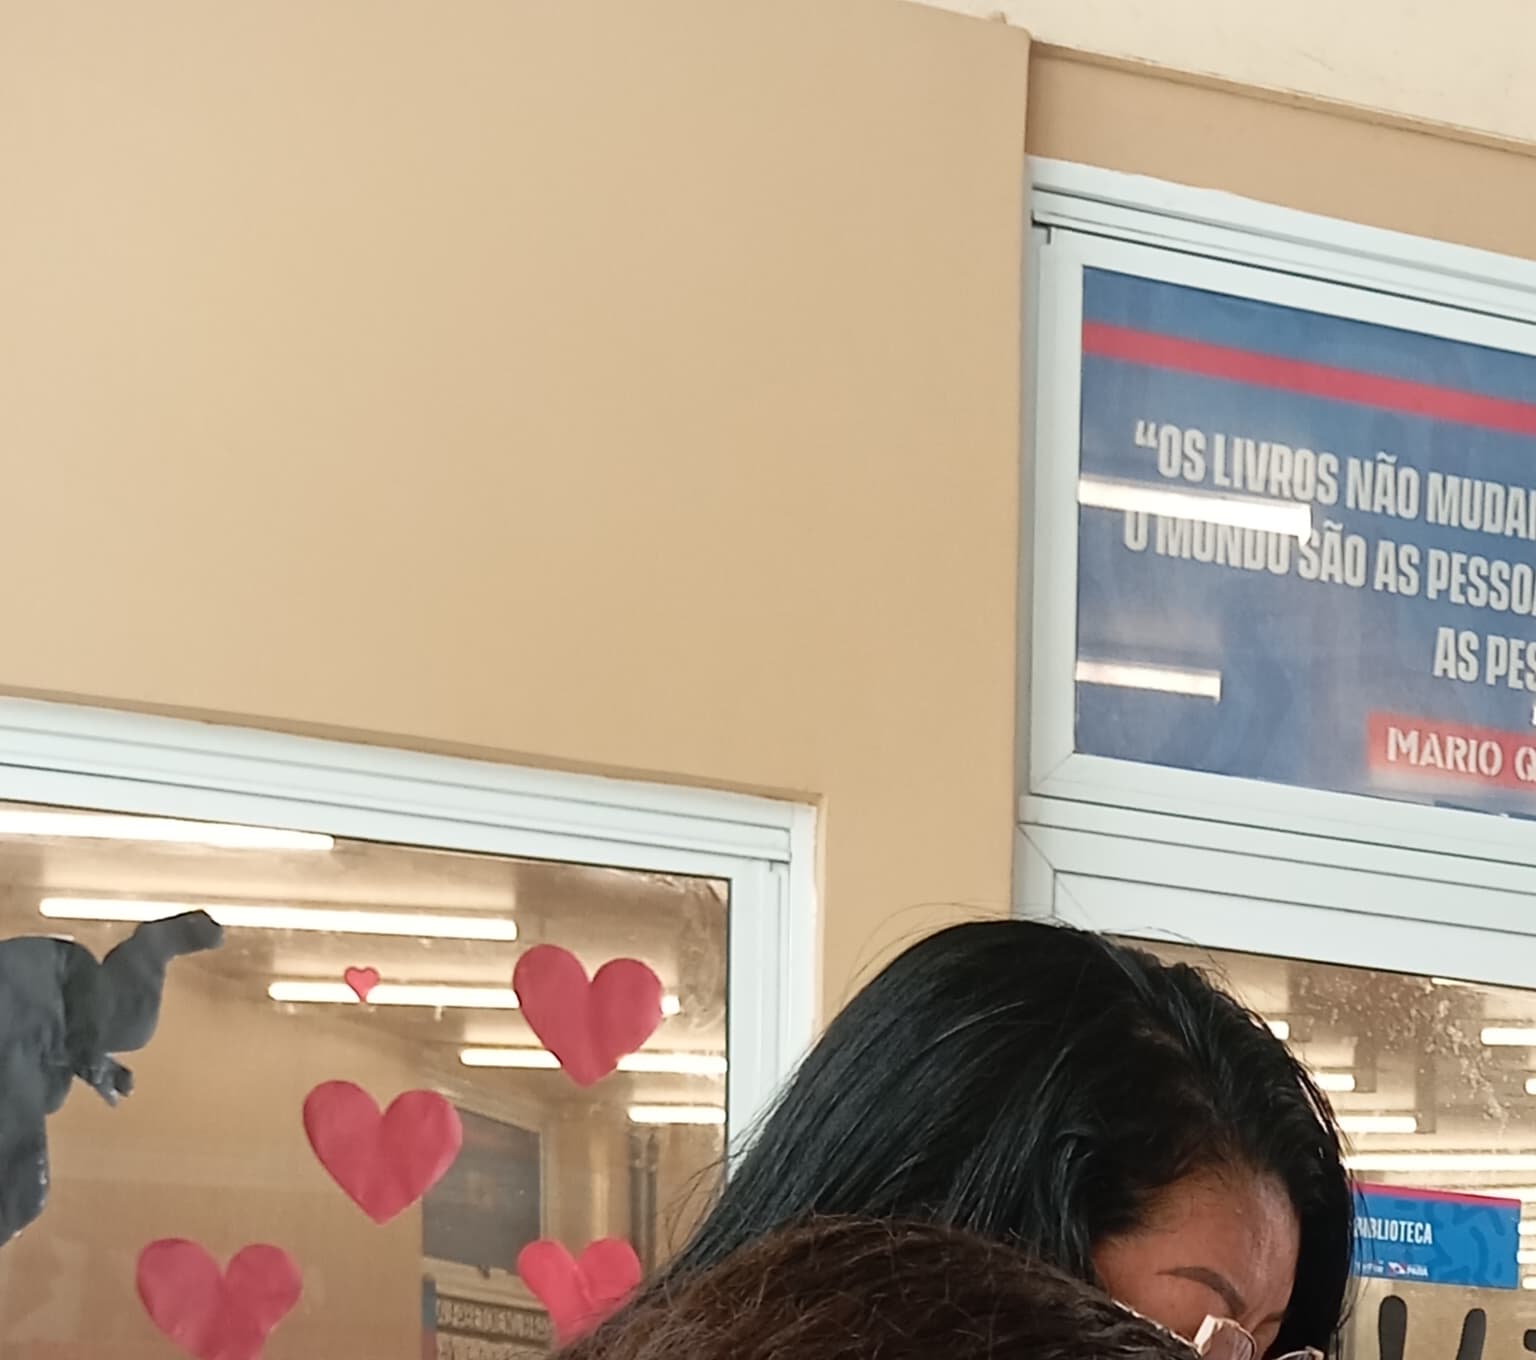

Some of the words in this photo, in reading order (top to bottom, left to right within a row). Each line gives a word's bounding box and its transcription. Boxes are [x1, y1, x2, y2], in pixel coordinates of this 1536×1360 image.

[1213, 434, 1339, 505] LIVROS
[1346, 452, 1419, 521] NÃO
[1155, 516, 1290, 575] MUNDO
[1299, 521, 1366, 588] SÃO
[1374, 539, 1418, 597] AS
[1433, 626, 1478, 683] AS
[1387, 727, 1501, 777] MARIO
